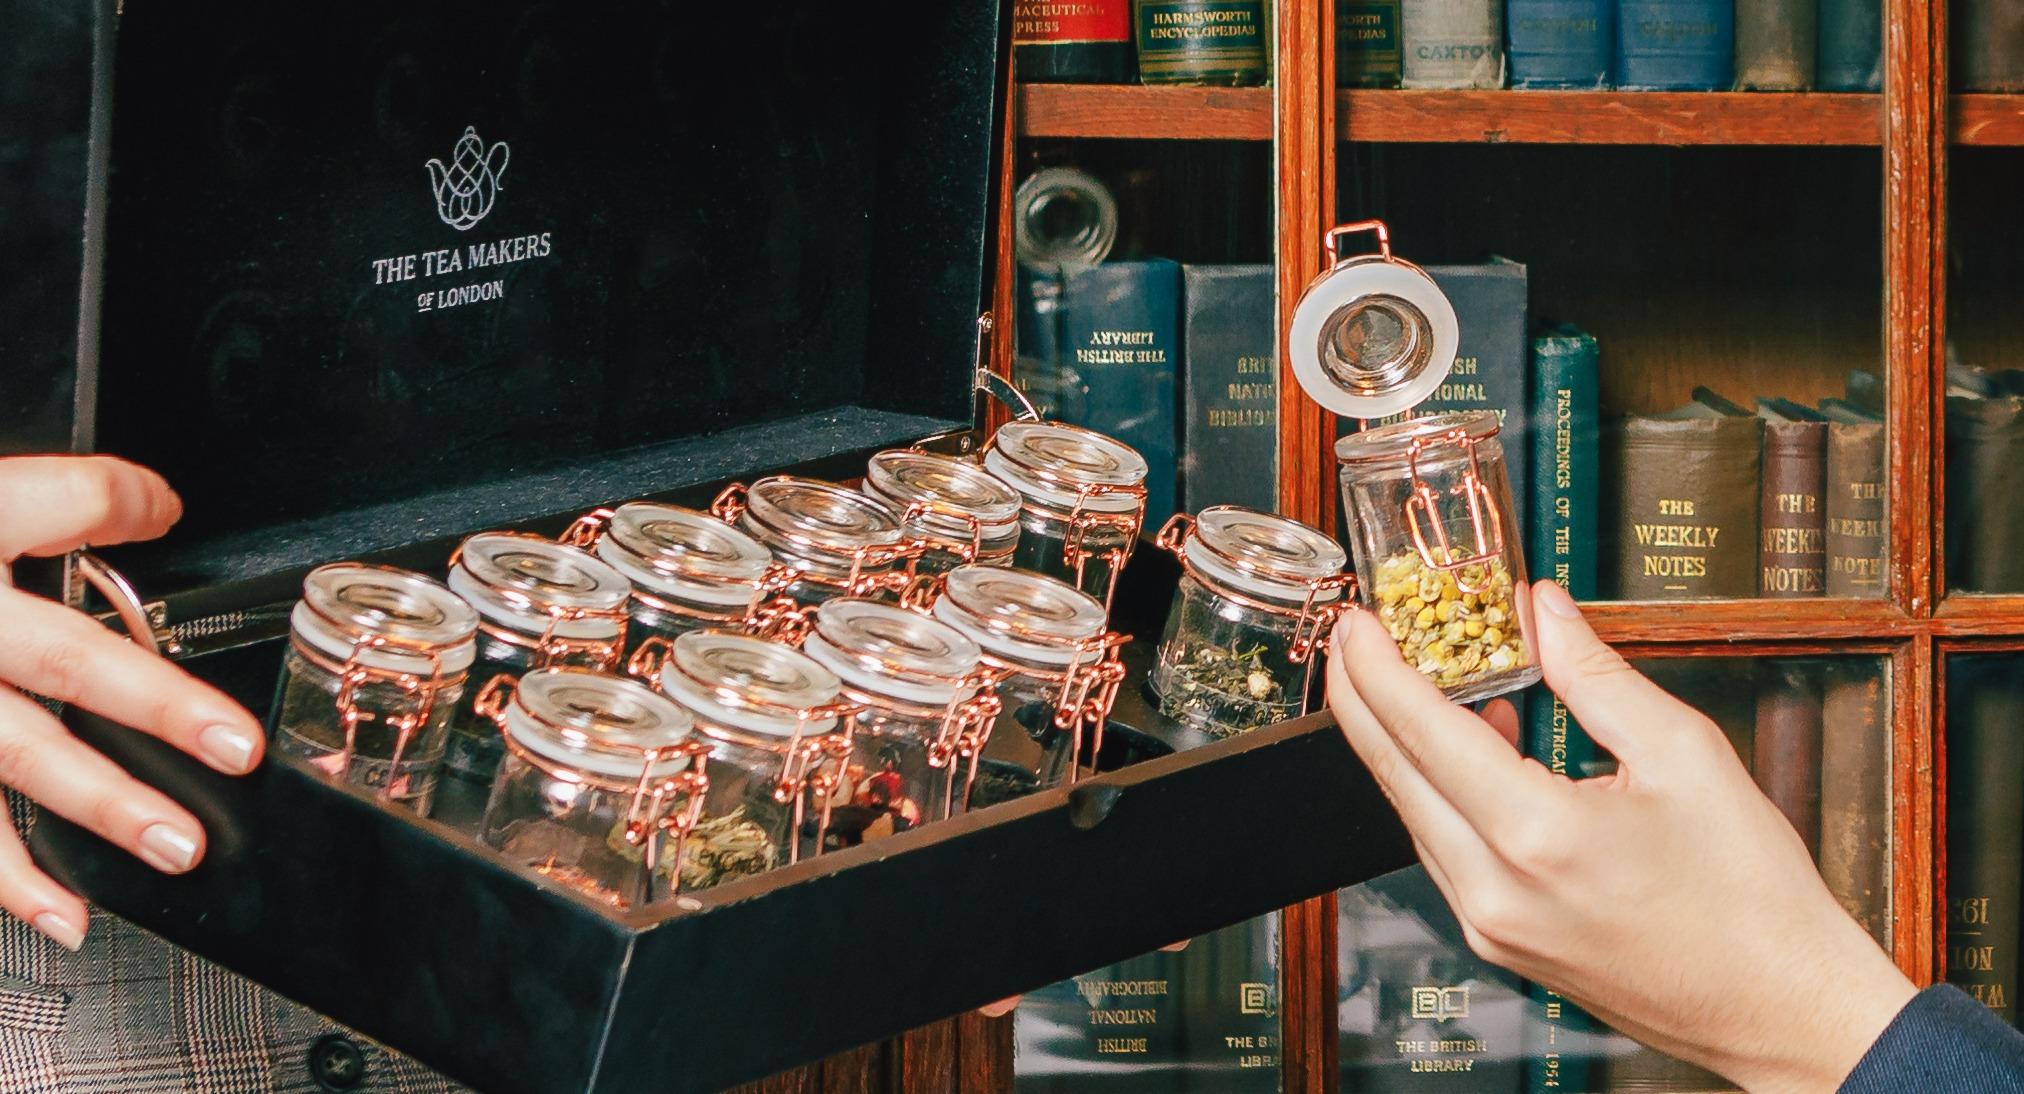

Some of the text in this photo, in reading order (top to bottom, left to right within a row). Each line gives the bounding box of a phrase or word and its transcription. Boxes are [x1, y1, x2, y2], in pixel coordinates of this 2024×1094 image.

[1153, 11, 1251, 24] HARMSWORTH
[1339, 15, 1381, 25] ORTH
[1016, 21, 1060, 33] PRESS
[1150, 25, 1256, 39] ENCYCLOPEDIAS
[372, 232, 551, 285] THE TEA MAKERS
[417, 280, 504, 312] OF LONDON
[1090, 331, 1154, 345] LIBRARY
[1076, 349, 1166, 364] THE BRITISH
[1450, 357, 1477, 375] SH
[1428, 383, 1487, 401] IONAL
[1555, 389, 1571, 591] PROCEEDINGS OF THE INS
[1659, 499, 1695, 516] THE
[1776, 493, 1816, 513] THE
[1634, 524, 1720, 548] WEEKLY
[1763, 528, 1825, 554] WEEKL
[1643, 555, 1707, 577] NOTES
[1552, 694, 1567, 775] LECTRICA
[1088, 1009, 1157, 1025] NATIONAL
[1097, 1038, 1148, 1053] BRITISH
[1225, 1036, 1254, 1048] THE
[1396, 1040, 1487, 1053] THE BRITISH
[1240, 1055, 1280, 1068] LIBR
[1410, 1060, 1474, 1073] LIBRARY
